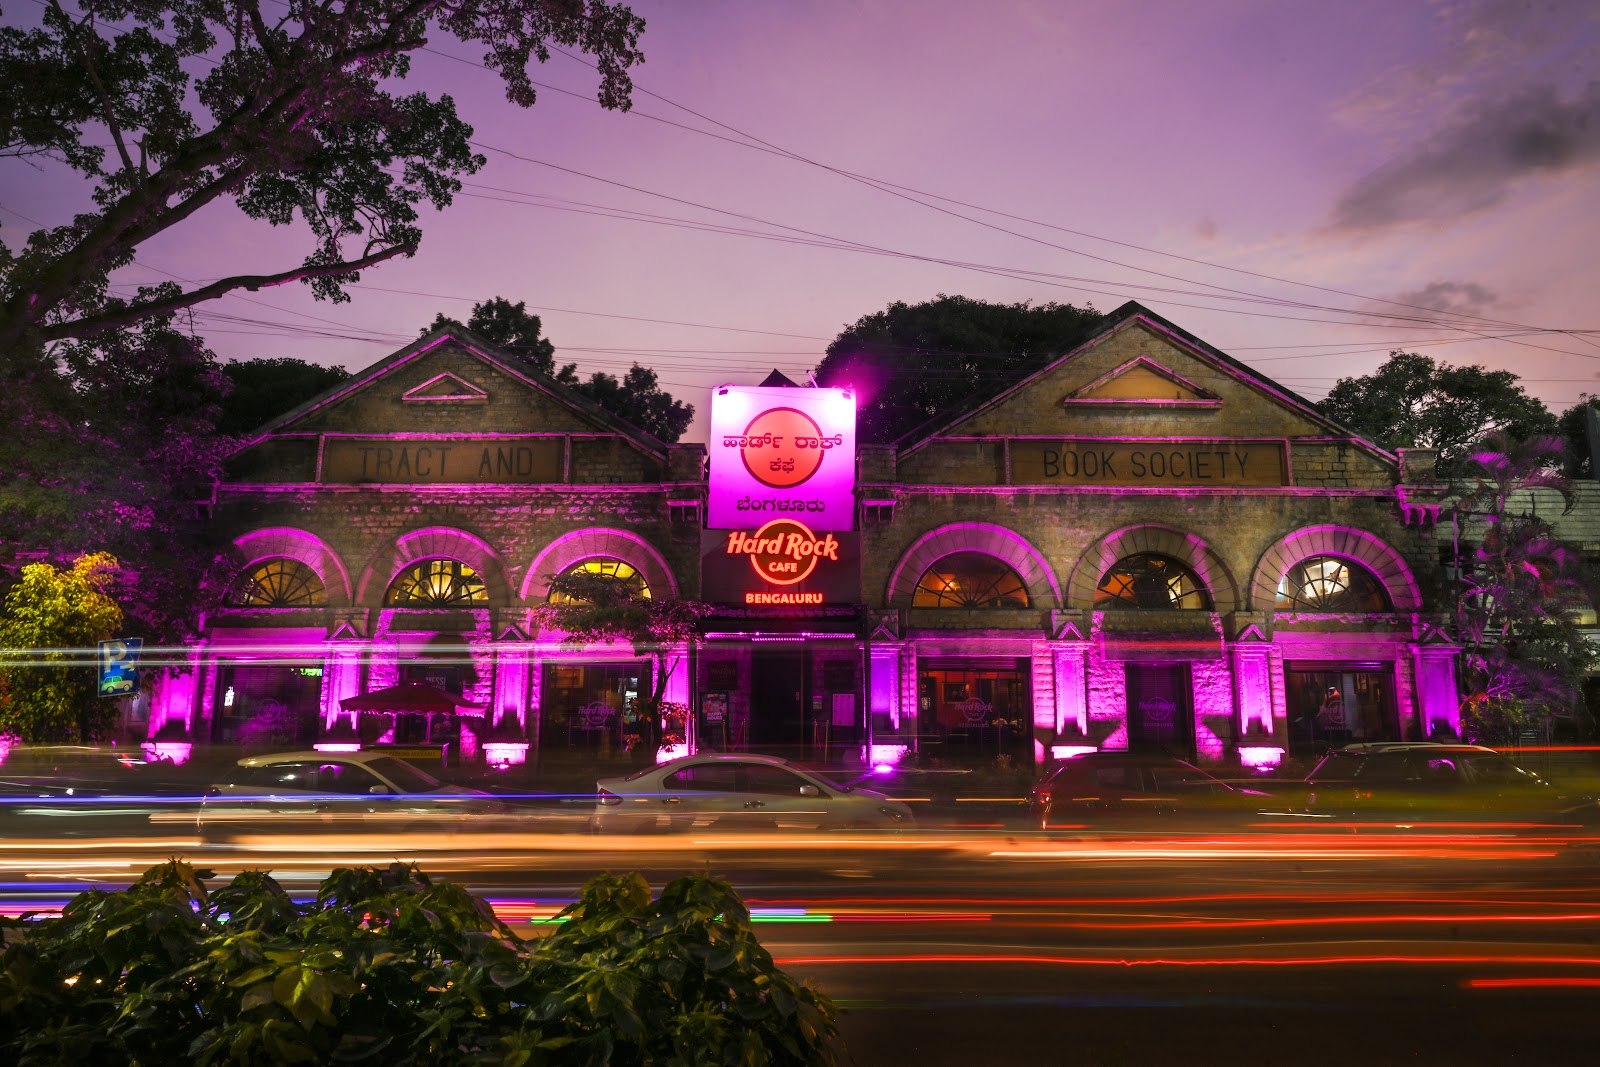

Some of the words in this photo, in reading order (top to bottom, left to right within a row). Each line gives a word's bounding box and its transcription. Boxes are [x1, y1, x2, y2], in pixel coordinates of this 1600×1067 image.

[723, 432, 784, 449] ಹಾರ್ಡ್
[795, 433, 842, 450] ರಾಕ್
[358, 447, 451, 477] TRACT
[478, 447, 533, 476] AND
[769, 457, 795, 474] ಕೆಫೆ
[1043, 450, 1117, 478] BOOK
[1131, 451, 1249, 479] SOCIETY
[736, 495, 826, 513] ಬೆಂಗಳೂರು
[727, 531, 785, 556] Hard
[786, 533, 839, 561] Rock
[768, 562, 797, 573] CAFE
[745, 593, 823, 604] BENGALURU
[103, 641, 127, 673] P
[577, 704, 597, 715] Hard
[954, 702, 974, 711] Hard
[974, 703, 993, 713] Rock
[1138, 701, 1158, 711] Hard
[1158, 702, 1177, 712] Rock
